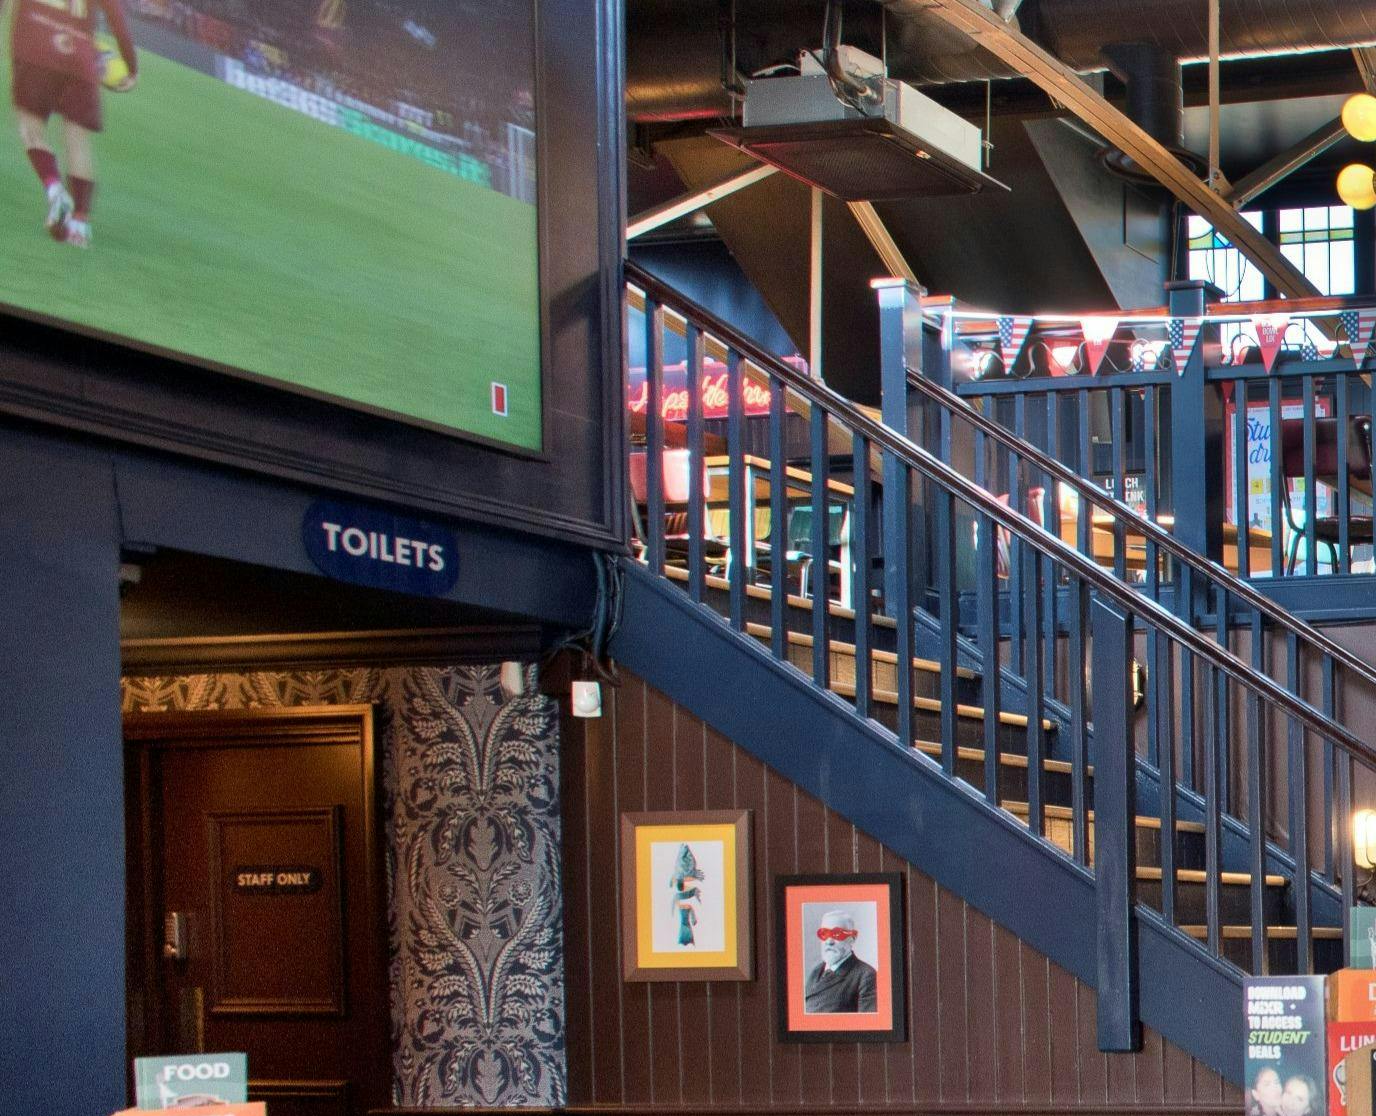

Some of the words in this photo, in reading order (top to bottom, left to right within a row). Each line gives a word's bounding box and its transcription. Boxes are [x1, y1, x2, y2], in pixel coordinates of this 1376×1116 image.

[322, 522, 445, 572] TOILETS
[238, 873, 273, 886] STAFF
[277, 872, 311, 885] ONLY
[1248, 1016, 1261, 1029] TO
[1248, 1031, 1311, 1044] STUDENT
[1249, 1045, 1281, 1059] DEALS
[163, 1062, 230, 1081] FOOD
